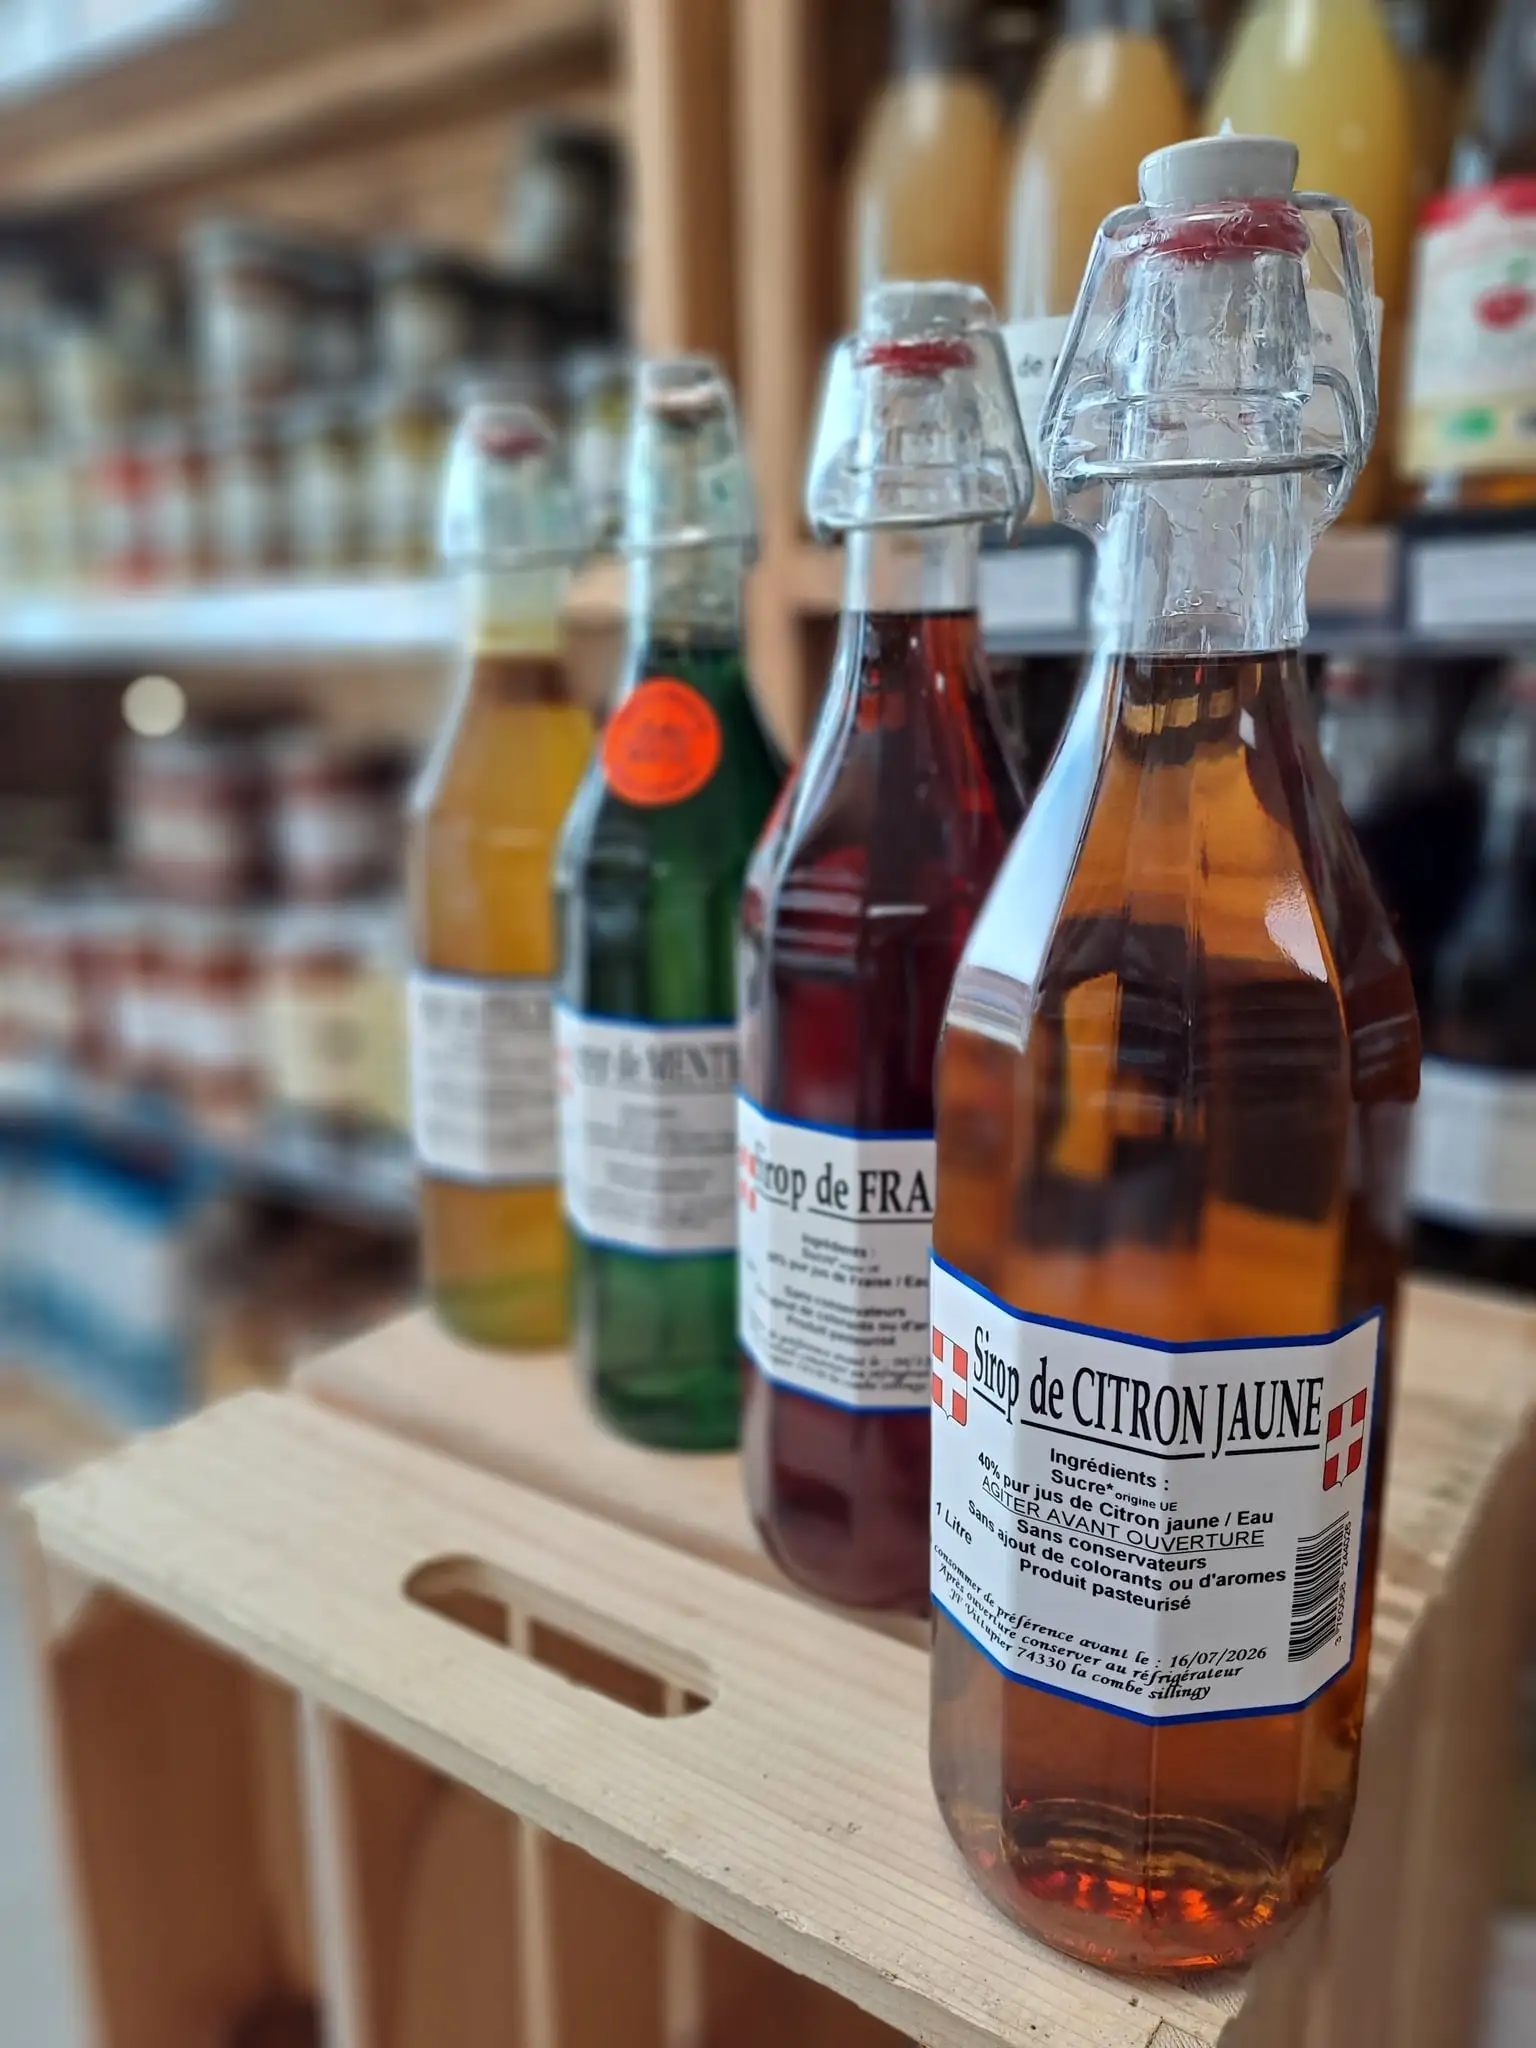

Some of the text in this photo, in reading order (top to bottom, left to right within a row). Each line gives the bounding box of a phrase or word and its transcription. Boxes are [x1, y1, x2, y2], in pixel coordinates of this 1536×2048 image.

[816, 1162, 849, 1210] de
[857, 1168, 933, 1213] FRA
[973, 1325, 1019, 1425] Sirop
[1030, 1356, 1064, 1419] de
[1072, 1366, 1208, 1446] CITRON
[1212, 1376, 1325, 1459] JAUNE
[978, 1452, 1001, 1479] 40%
[1003, 1475, 1031, 1495] pur
[1034, 1483, 1064, 1504] jus
[1070, 1493, 1093, 1512] de
[1099, 1501, 1160, 1530] Citron
[1164, 1515, 1220, 1535] jaune
[1237, 1510, 1274, 1526] Eau
[1050, 1448, 1157, 1488] Ingrédients
[944, 1508, 973, 1545] Litre
[982, 1475, 1265, 1553] AGITER AVANT OUVERTURE
[1115, 1491, 1157, 1510] origine
[1160, 1501, 1178, 1512] UE
[968, 1499, 1287, 1592] Sans ajout de colorants ou d'aromes
[1017, 1519, 1207, 1572] Sans conservateurs
[933, 1543, 983, 1594] consommer
[983, 1590, 995, 1608] de
[996, 1605, 1075, 1643] préférence
[1079, 1638, 1129, 1660] avant
[1135, 1651, 1150, 1666] le
[1169, 1646, 1268, 1670] 16/07/2026
[1019, 1557, 1192, 1612] Produit pasteurisé
[966, 1591, 1017, 1639] ouverture
[1021, 1633, 1103, 1666] conserver
[1105, 1662, 1128, 1675] au
[1132, 1665, 1244, 1687] réfrigérateur
[1016, 1646, 1067, 1672] 74330
[1070, 1661, 1087, 1679] la
[1091, 1673, 1144, 1696] combe
